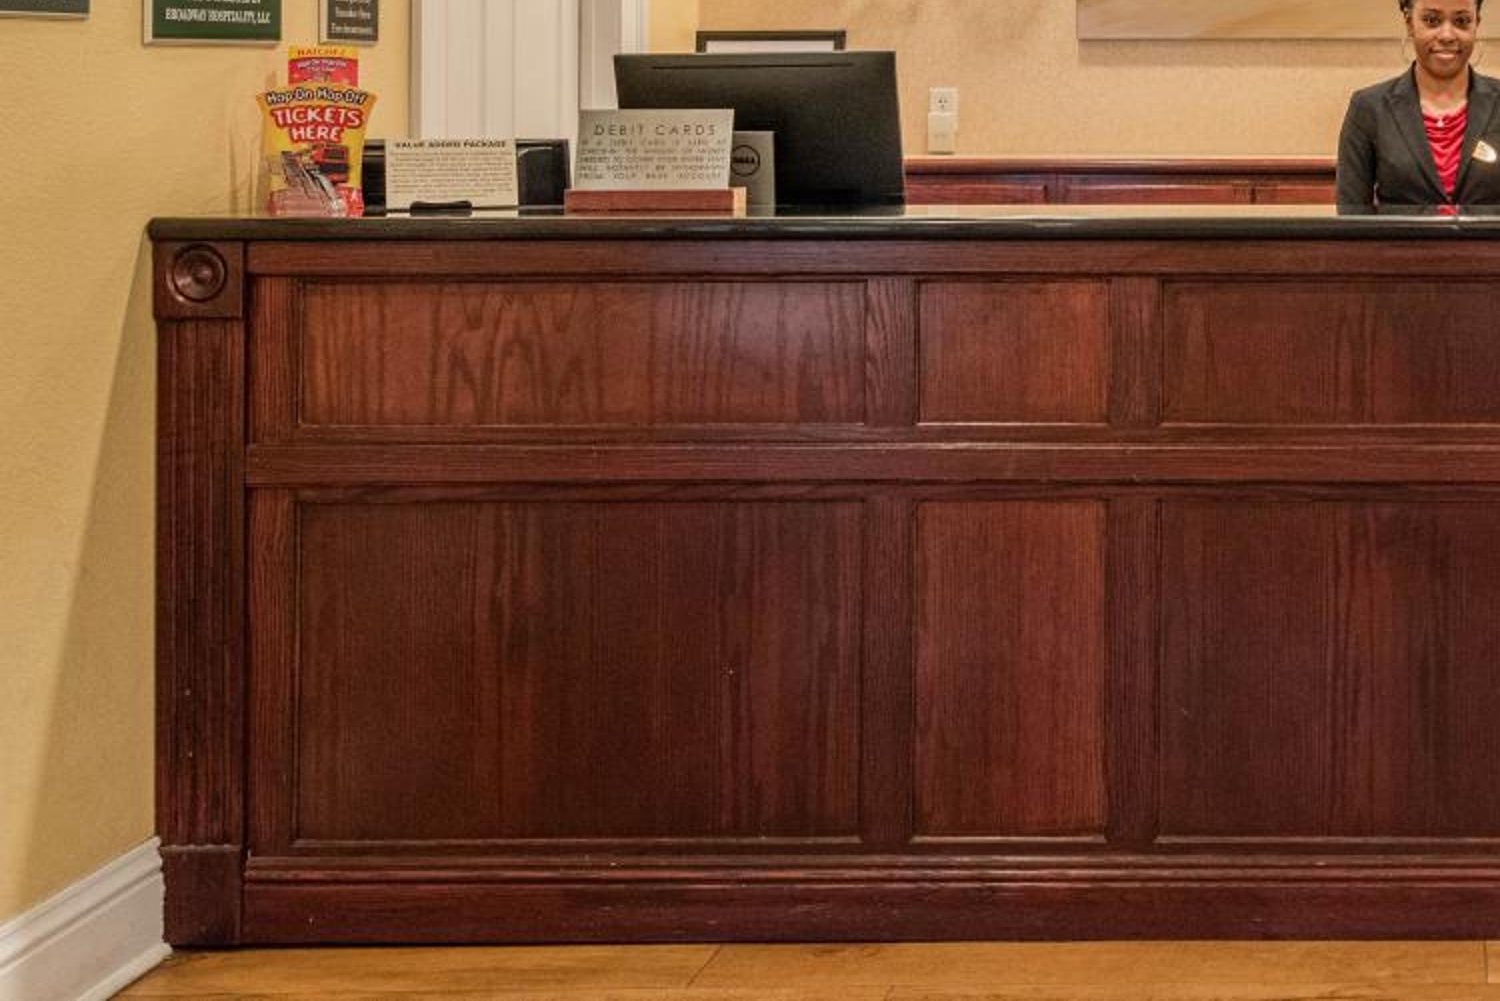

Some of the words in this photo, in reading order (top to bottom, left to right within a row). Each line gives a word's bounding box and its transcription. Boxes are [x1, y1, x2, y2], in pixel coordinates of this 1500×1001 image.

[266, 91, 293, 105] Hop
[316, 86, 343, 103] Hop
[272, 106, 362, 127] TICKETS
[291, 125, 341, 142] HERE
[593, 124, 644, 136] DEBIT
[655, 124, 716, 136] CARDS
